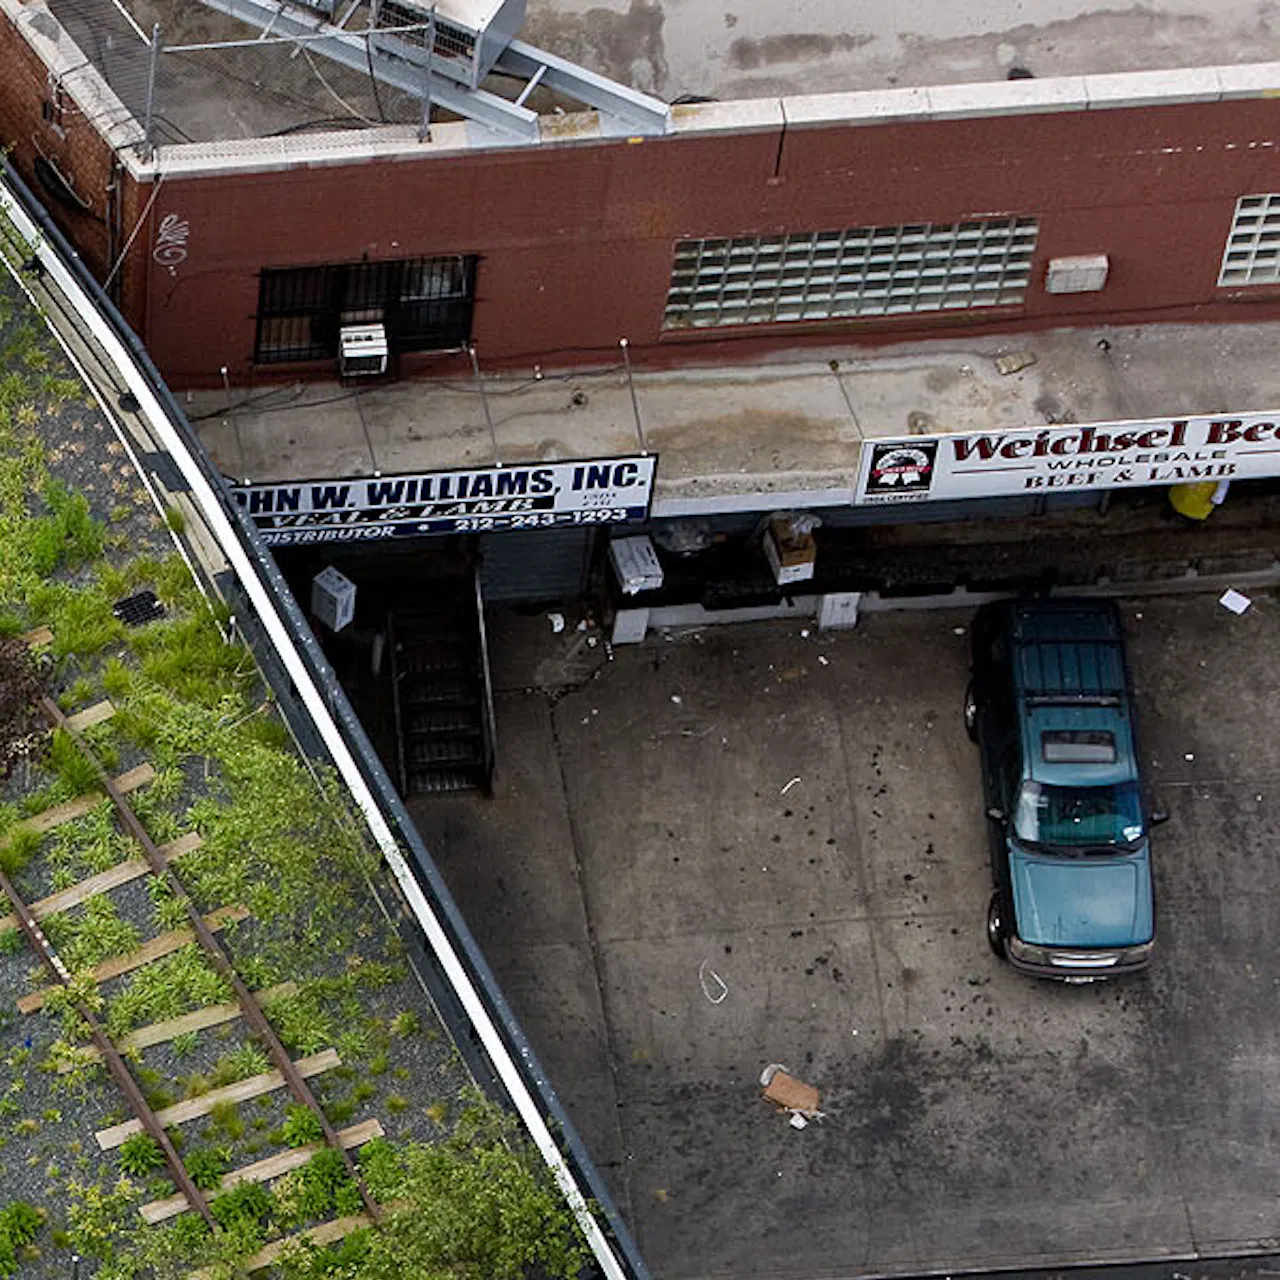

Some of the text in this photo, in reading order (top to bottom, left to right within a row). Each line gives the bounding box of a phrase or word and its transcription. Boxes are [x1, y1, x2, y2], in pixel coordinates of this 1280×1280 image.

[952, 421, 1189, 461] Weichsel
[1206, 420, 1280, 446] Be
[1048, 450, 1227, 470] WHOLESALE
[231, 488, 301, 514] OHN
[311, 485, 357, 510] W.
[366, 468, 561, 506] WILLIAMS,
[572, 462, 646, 491] INC.
[1024, 463, 1236, 489] BEEF & LAMB
[272, 498, 535, 528] VEAL & LAMB
